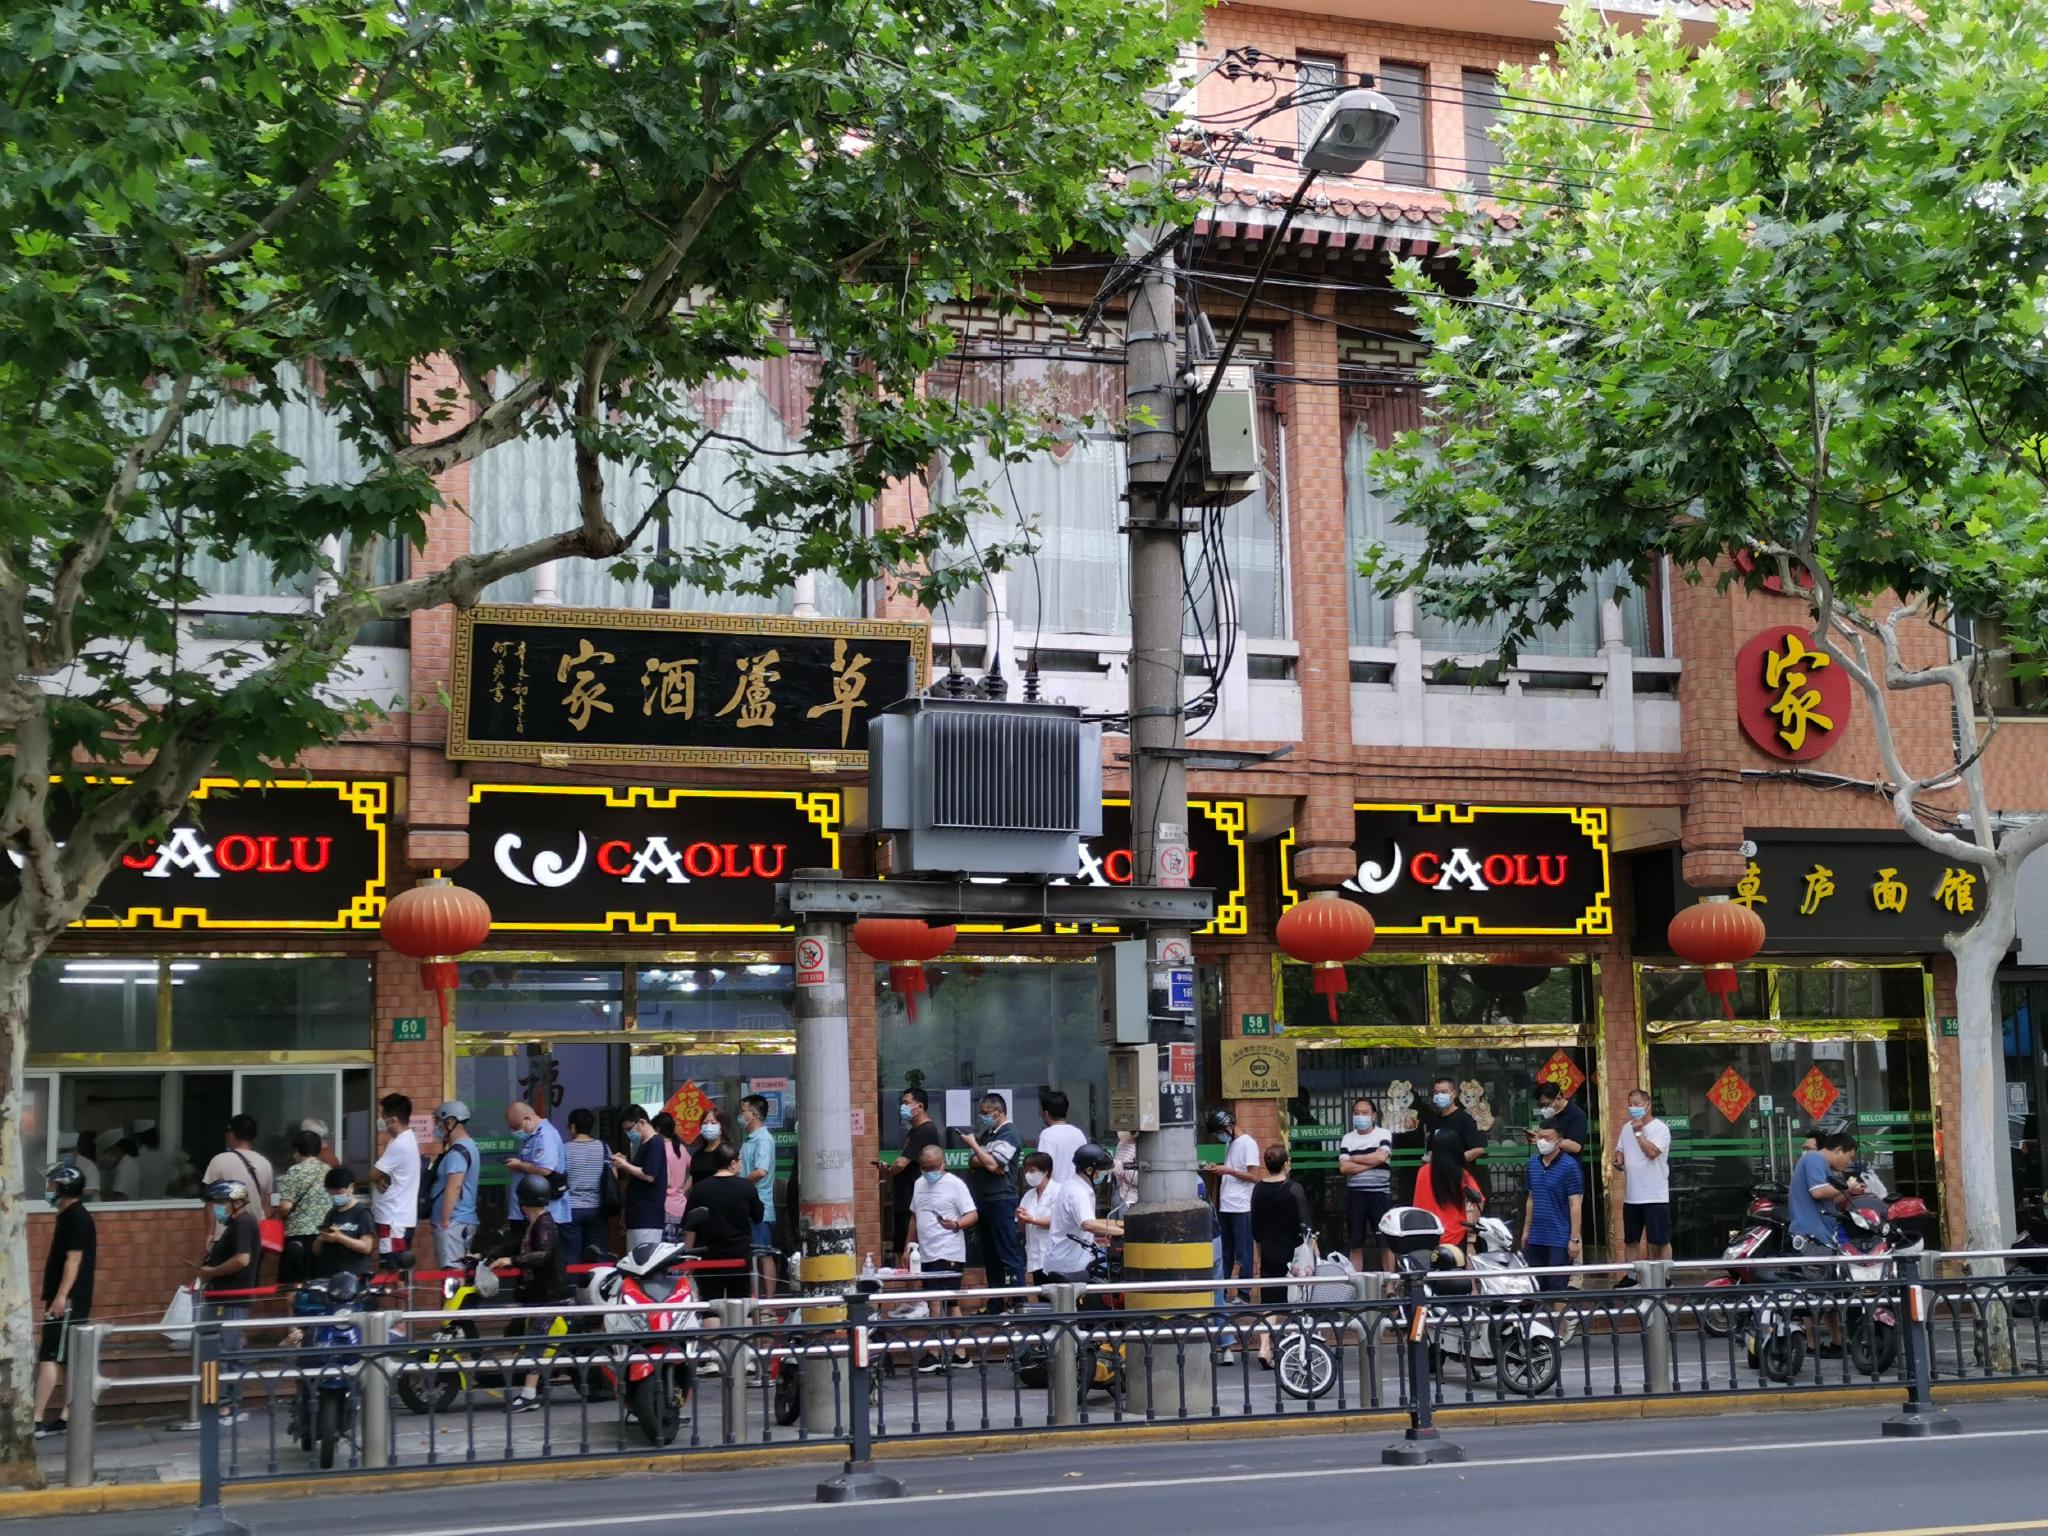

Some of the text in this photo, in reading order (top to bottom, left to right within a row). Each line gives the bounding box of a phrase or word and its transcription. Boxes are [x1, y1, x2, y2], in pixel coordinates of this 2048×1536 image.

[1766, 633, 1833, 751] 家
[596, 836, 787, 884] CAOLU
[1409, 847, 1569, 892] CAOLU
[401, 1020, 418, 1033] 60
[1248, 1016, 1263, 1028] 58
[1546, 1061, 1574, 1092] 福
[1720, 1075, 1743, 1104] 福
[1805, 1074, 1829, 1103] 福
[674, 1091, 705, 1122] 福
[1860, 1114, 1894, 1122] WELCOME
[1301, 1128, 1342, 1136] WELCOME
